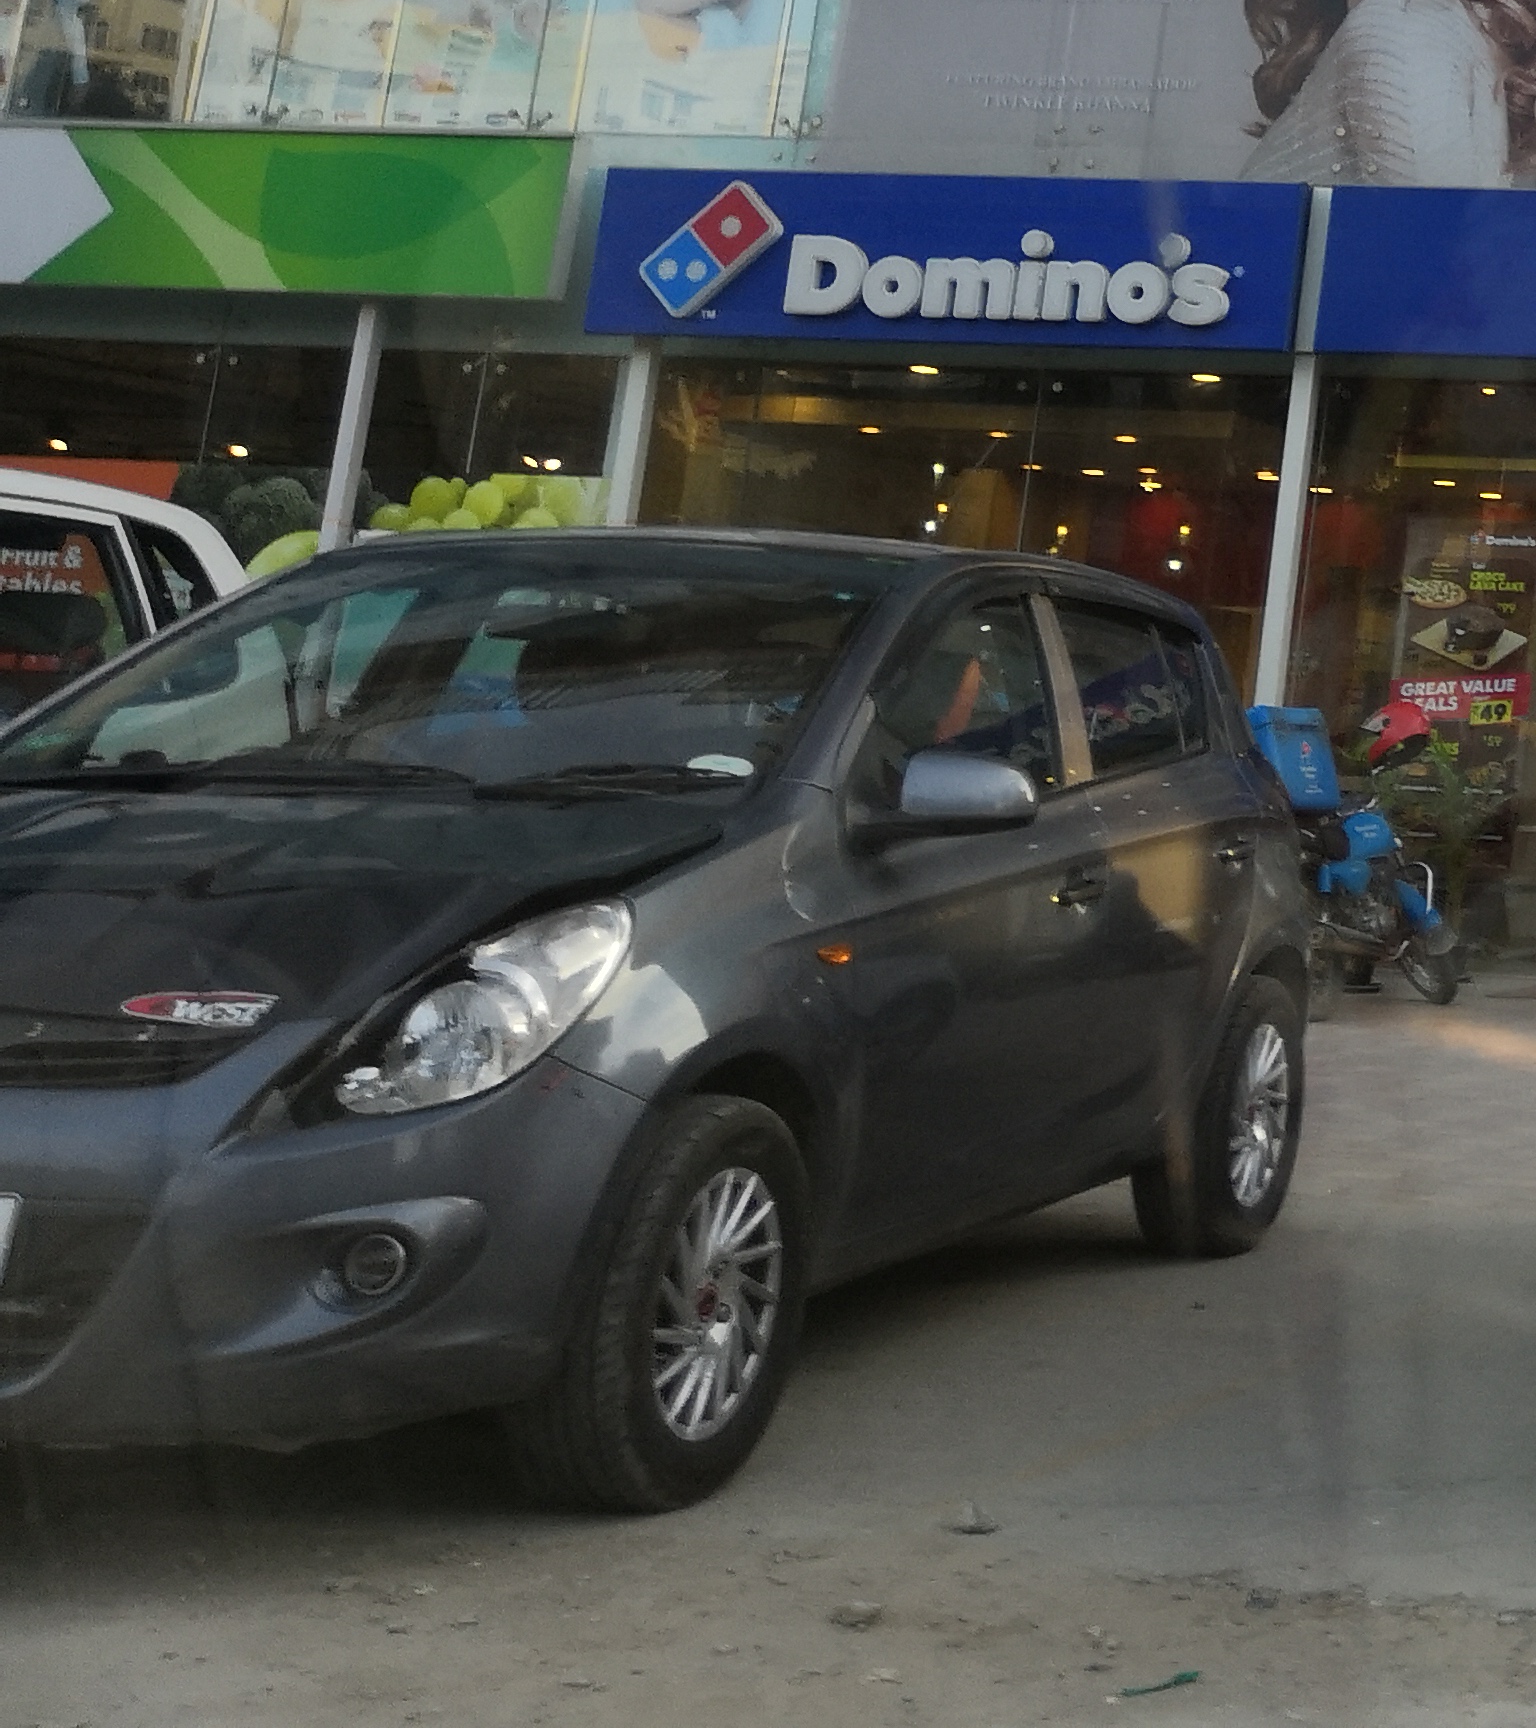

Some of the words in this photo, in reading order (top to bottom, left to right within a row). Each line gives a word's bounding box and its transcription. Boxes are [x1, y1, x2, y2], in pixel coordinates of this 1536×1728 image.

[782, 228, 1232, 328] Domino's
[1400, 681, 1457, 697] GREAT
[1460, 678, 1517, 694] VALUE
[1401, 696, 1459, 712] EALS
